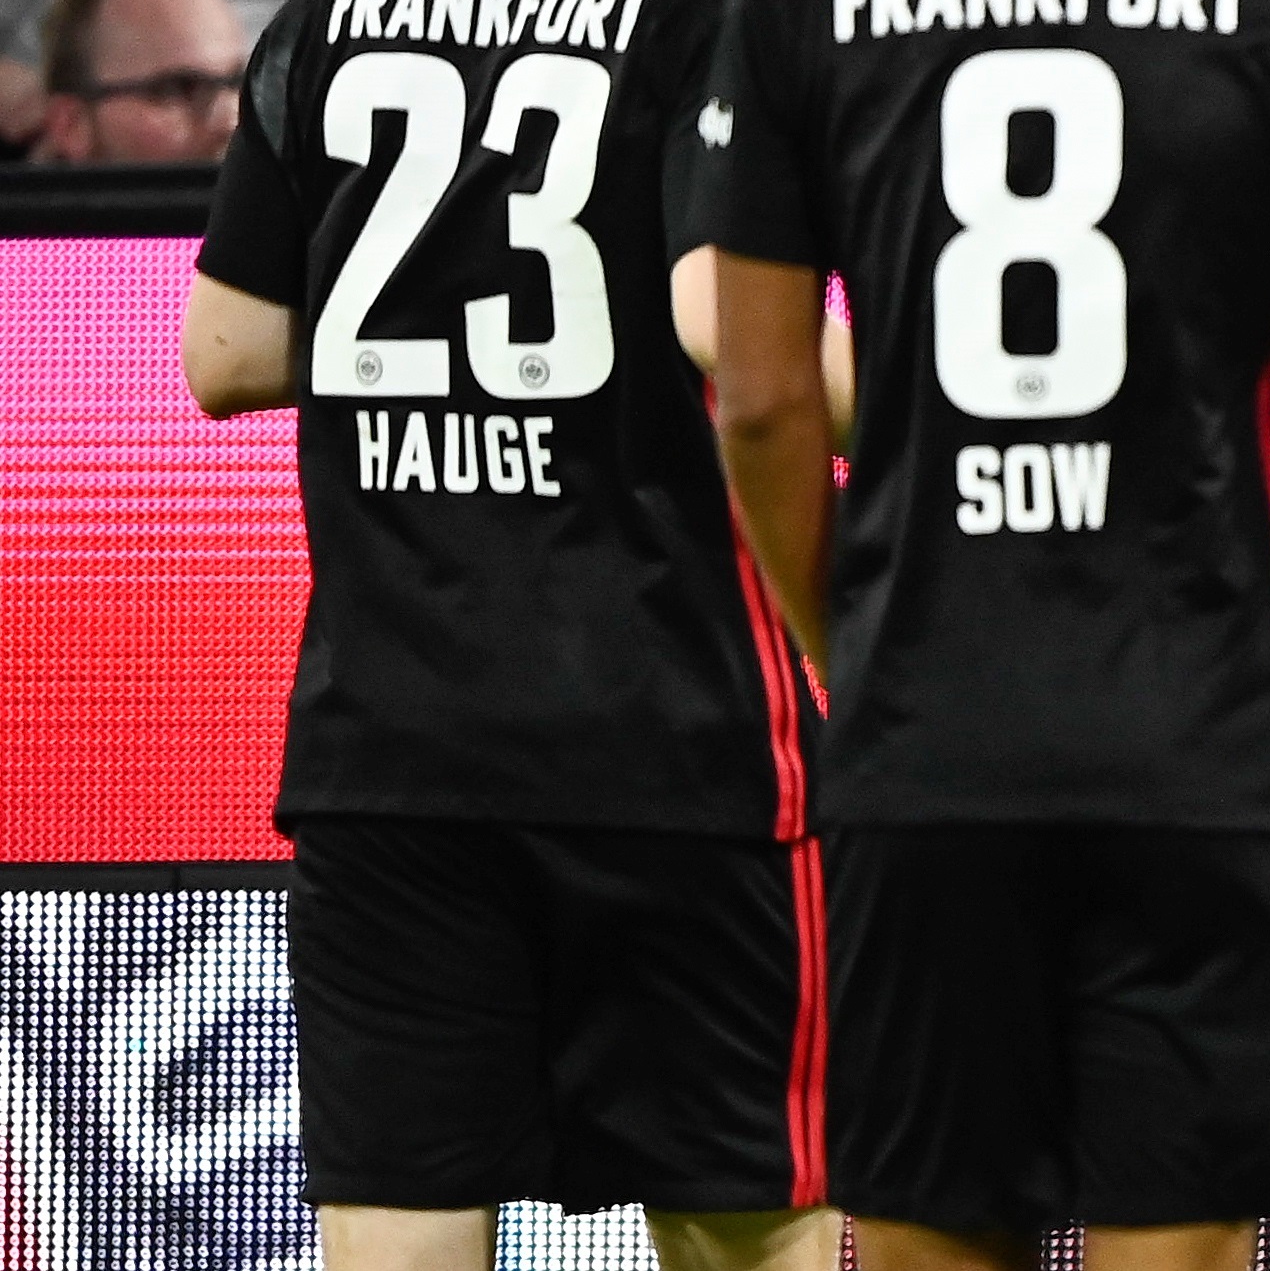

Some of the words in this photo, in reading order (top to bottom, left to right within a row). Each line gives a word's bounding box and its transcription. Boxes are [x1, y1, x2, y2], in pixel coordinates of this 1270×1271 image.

[312, 51, 615, 400] 23
[932, 47, 1128, 420] 8
[355, 410, 562, 497] HAUGE
[955, 441, 1112, 536] SOW
